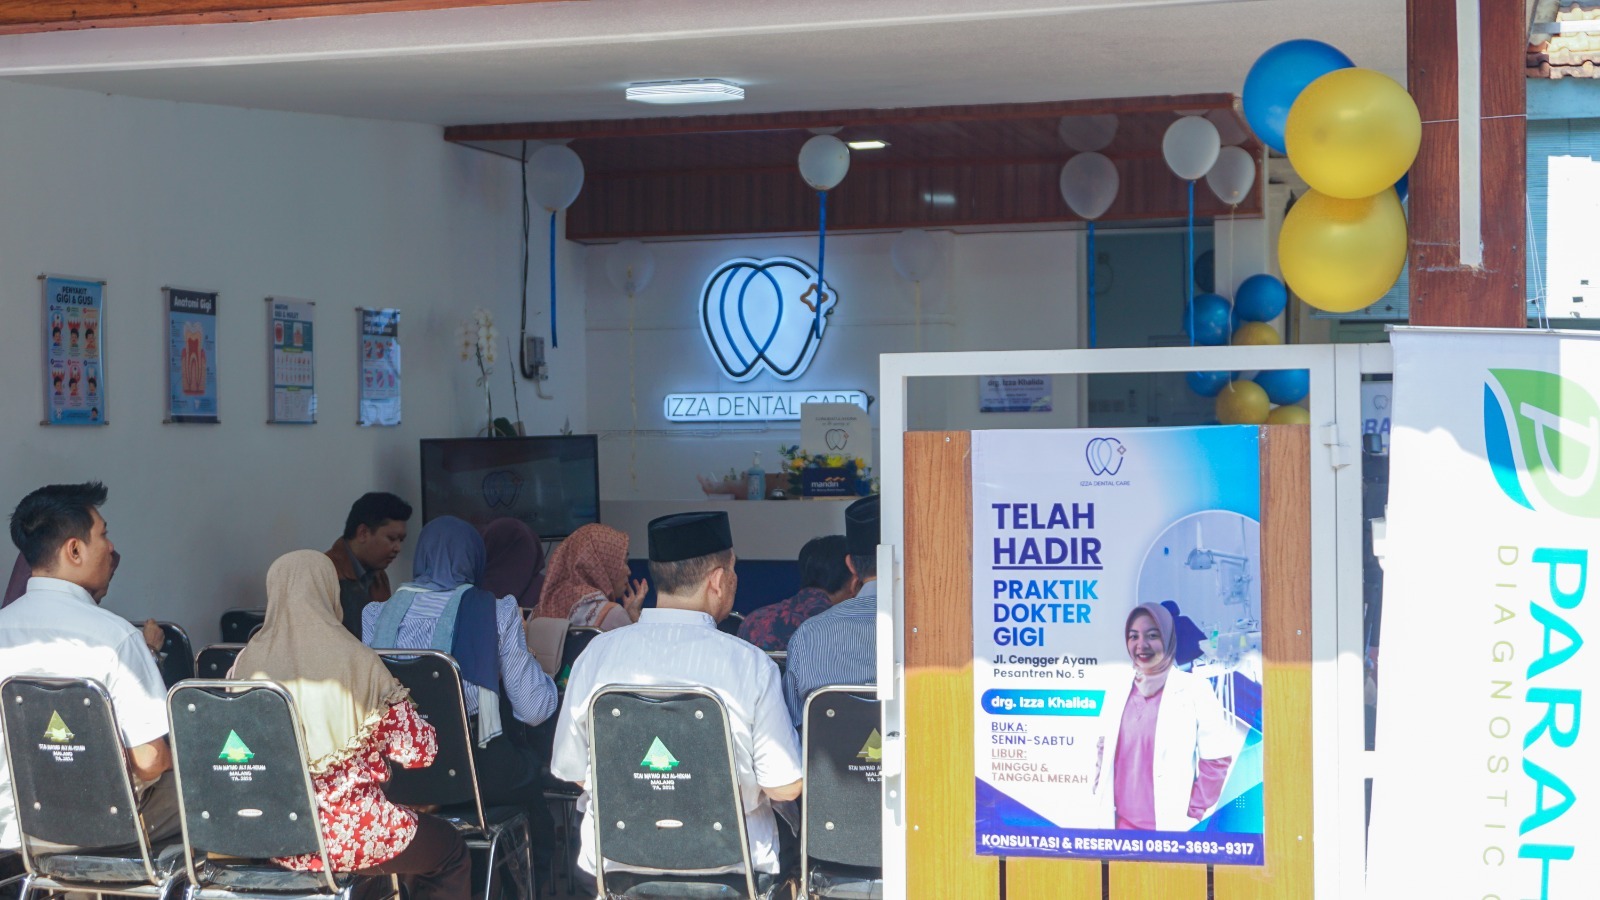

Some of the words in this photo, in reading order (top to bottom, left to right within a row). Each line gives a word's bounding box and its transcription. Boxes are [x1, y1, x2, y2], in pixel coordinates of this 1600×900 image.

[56, 293, 71, 304] GIGI
[77, 295, 93, 305] GUSI
[667, 396, 711, 417] IZZA
[717, 395, 799, 417] DENTAL
[992, 503, 1095, 530] TELAH
[993, 537, 1102, 565] HADIR
[993, 579, 1098, 600] PRAKTIK
[993, 603, 1091, 623] DOKTER
[993, 627, 1044, 647] GIGI
[993, 655, 1007, 665] Jl.
[1008, 655, 1059, 669] Cengger
[1062, 656, 1098, 669] Ayam
[993, 668, 1053, 678] Pesantren
[1056, 669, 1075, 679] No.
[1078, 669, 1085, 679] 5
[991, 695, 1016, 712] drg.
[1019, 696, 1044, 709] Izza
[1048, 695, 1097, 709] Khalida
[1483, 545, 1519, 867] DIAGNOSTIC
[991, 722, 1028, 733] BUKA:
[991, 734, 1074, 746] SENIN-SABTU
[991, 748, 1027, 760] LIBUR:
[991, 762, 1038, 773] MINGGU
[1040, 763, 1048, 773] &
[991, 772, 1045, 783] TANGGAL
[1048, 773, 1088, 784] MERAH
[982, 833, 1060, 849] KONSULTASI
[1062, 837, 1072, 850] &
[1074, 838, 1144, 852] RESERVASI
[1145, 840, 1254, 855] 0852-3693-9317
